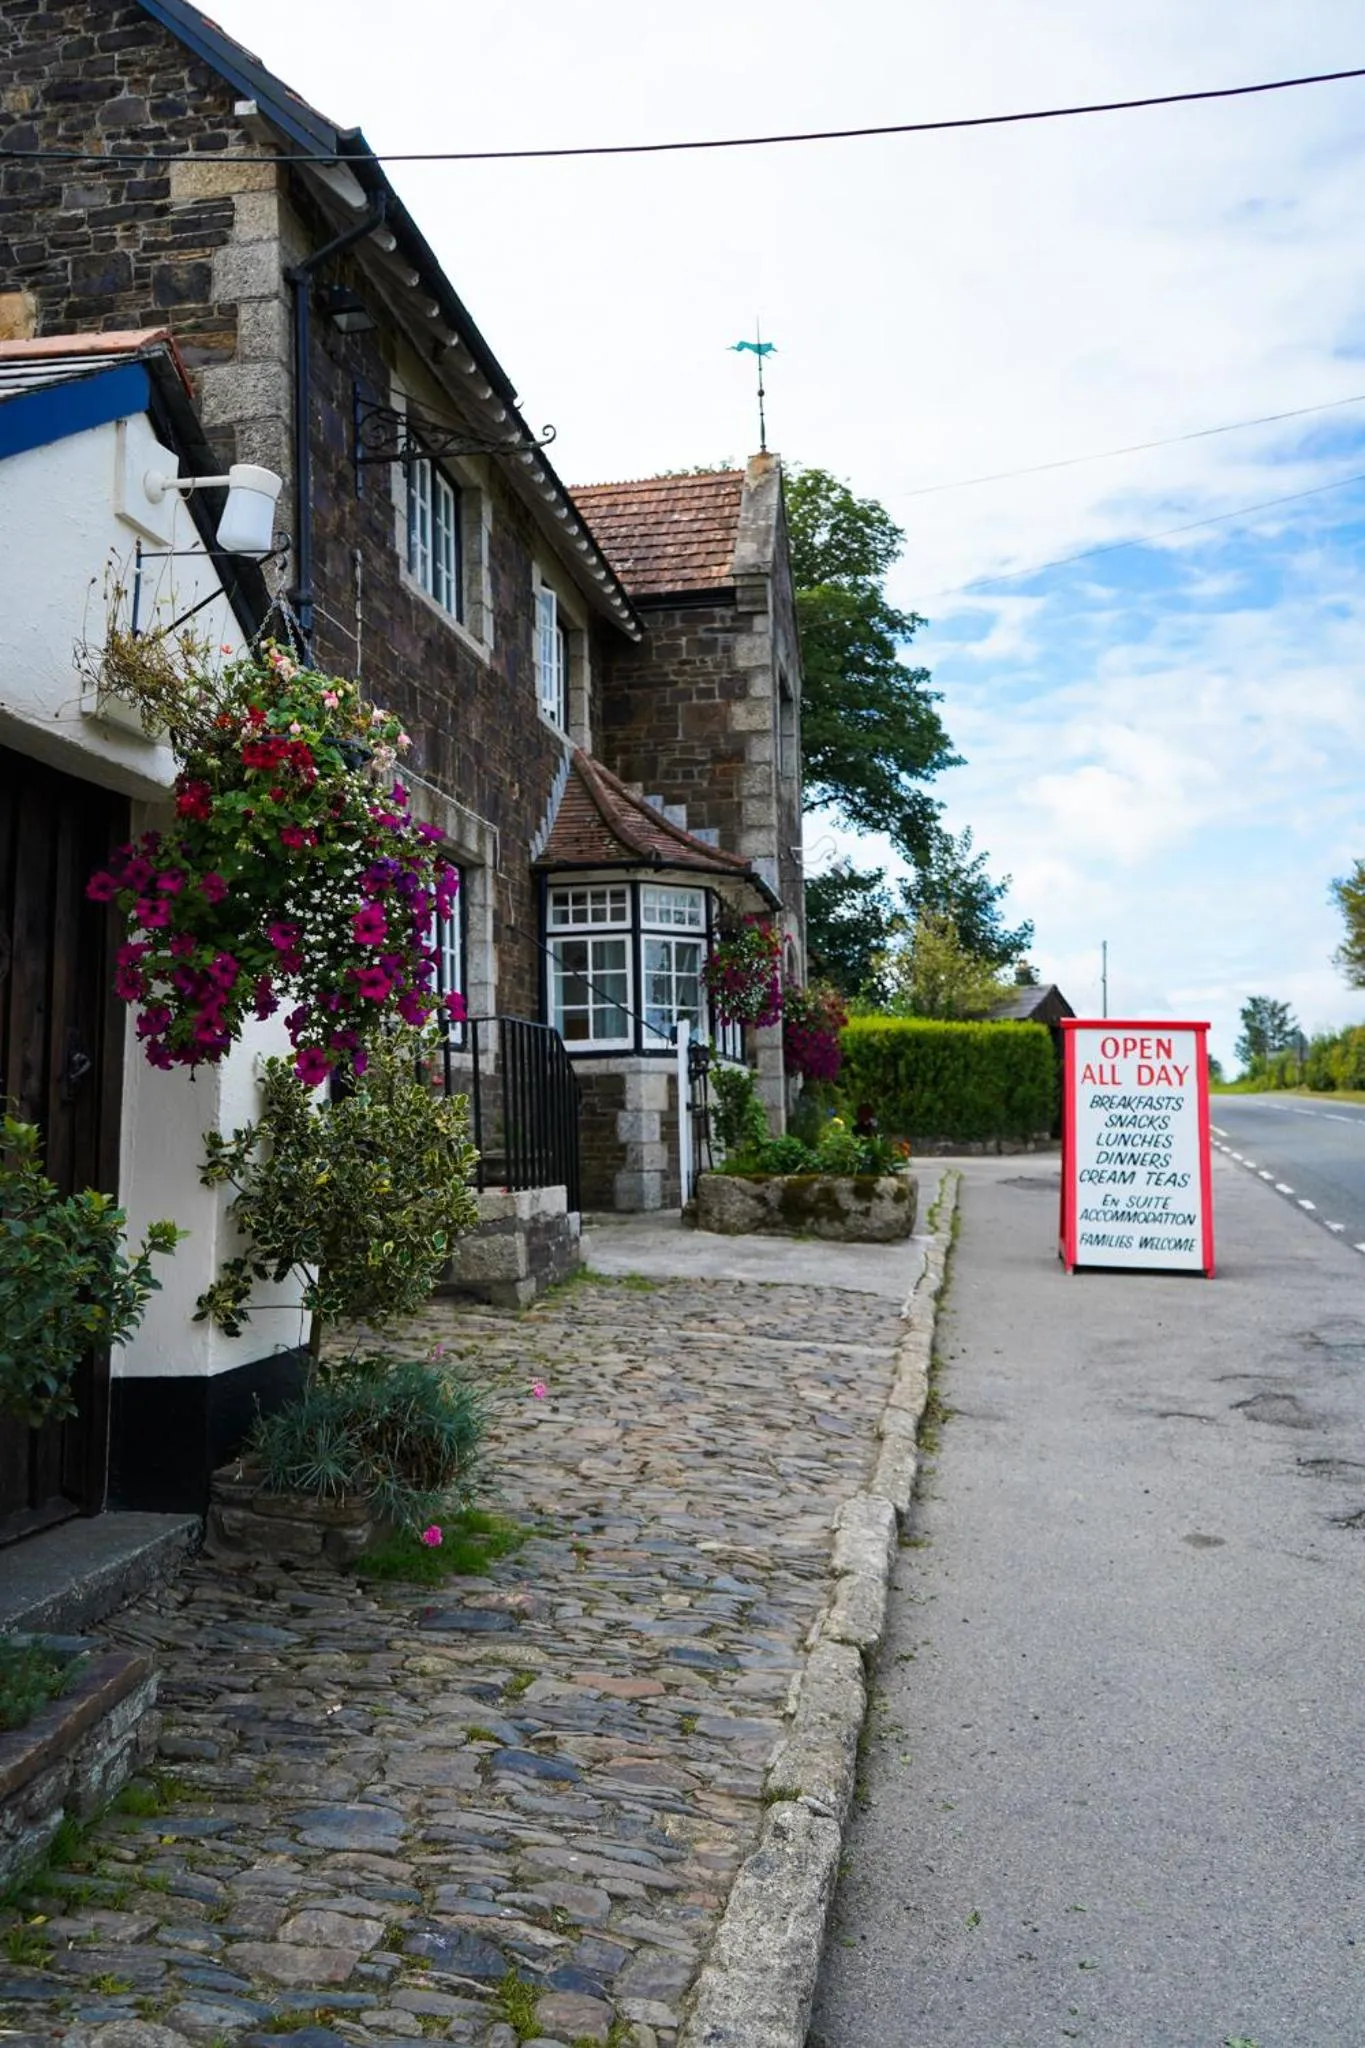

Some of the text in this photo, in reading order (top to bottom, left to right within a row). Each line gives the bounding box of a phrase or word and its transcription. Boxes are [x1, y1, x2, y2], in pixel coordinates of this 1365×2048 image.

[1101, 1037, 1173, 1059] OPEN
[1081, 1064, 1189, 1087] ALL DAY
[1089, 1095, 1184, 1112] BREAKFASTS
[1105, 1115, 1170, 1131] SNACKS
[1096, 1132, 1174, 1148] LUNCHES
[1096, 1151, 1172, 1168] DINNERS
[1079, 1169, 1190, 1188] CREAM TEAS
[1126, 1196, 1173, 1210] SUITE
[1079, 1209, 1196, 1226] ACCOMMODATION
[1079, 1233, 1197, 1252] FAMILIES WELCOME
